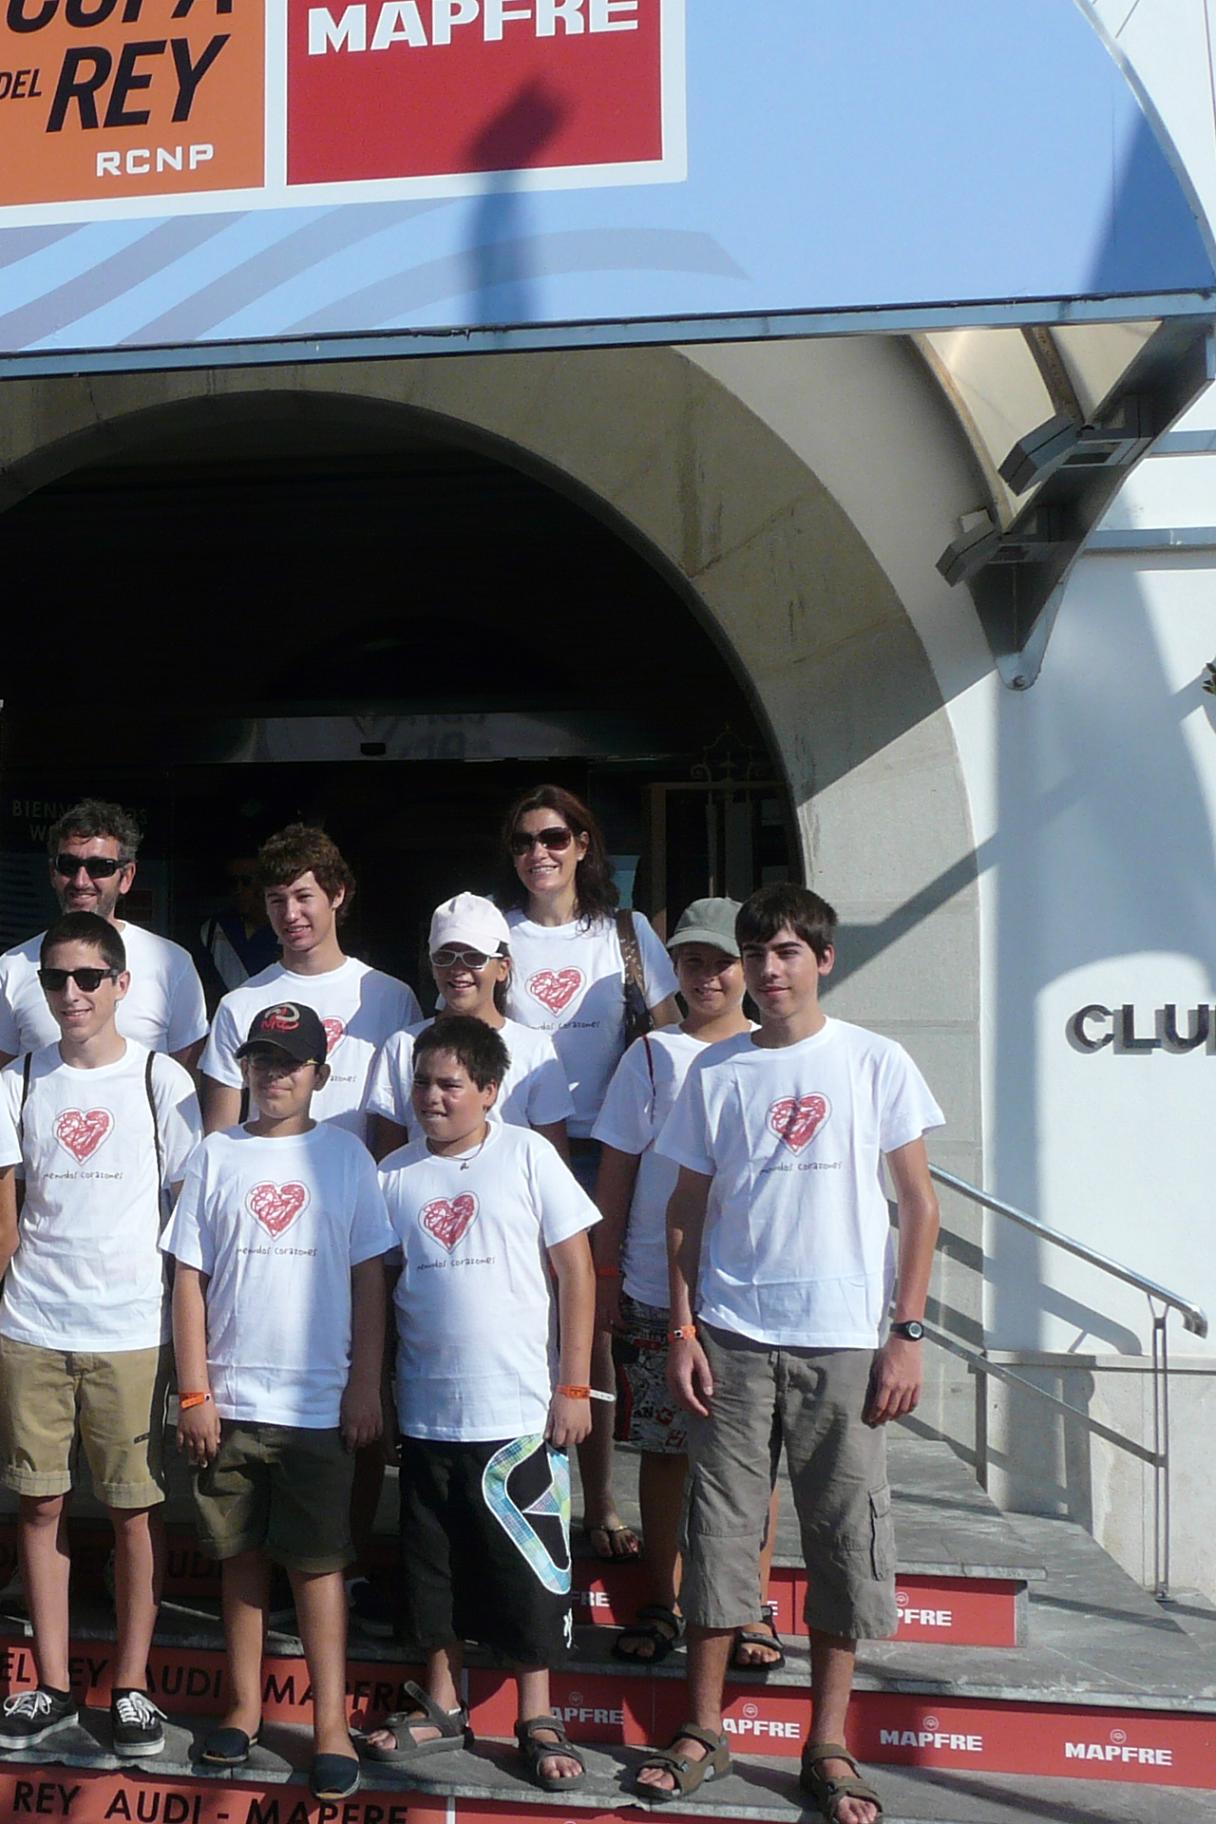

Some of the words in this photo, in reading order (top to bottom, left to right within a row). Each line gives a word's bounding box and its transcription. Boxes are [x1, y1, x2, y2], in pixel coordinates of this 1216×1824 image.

[308, 0, 638, 55] MAPFRE
[46, 34, 231, 133] REY
[96, 144, 214, 176] RCNP
[1073, 1004, 1216, 1049] CLU
[69, 1657, 108, 1688] EY
[552, 1706, 624, 1724] APFRE
[722, 1718, 800, 1738] APFRE
[880, 1729, 983, 1751] MAPFRE
[1065, 1742, 1173, 1766] MAPFRE
[14, 1781, 82, 1815] REY
[105, 1790, 202, 1824] AUDI
